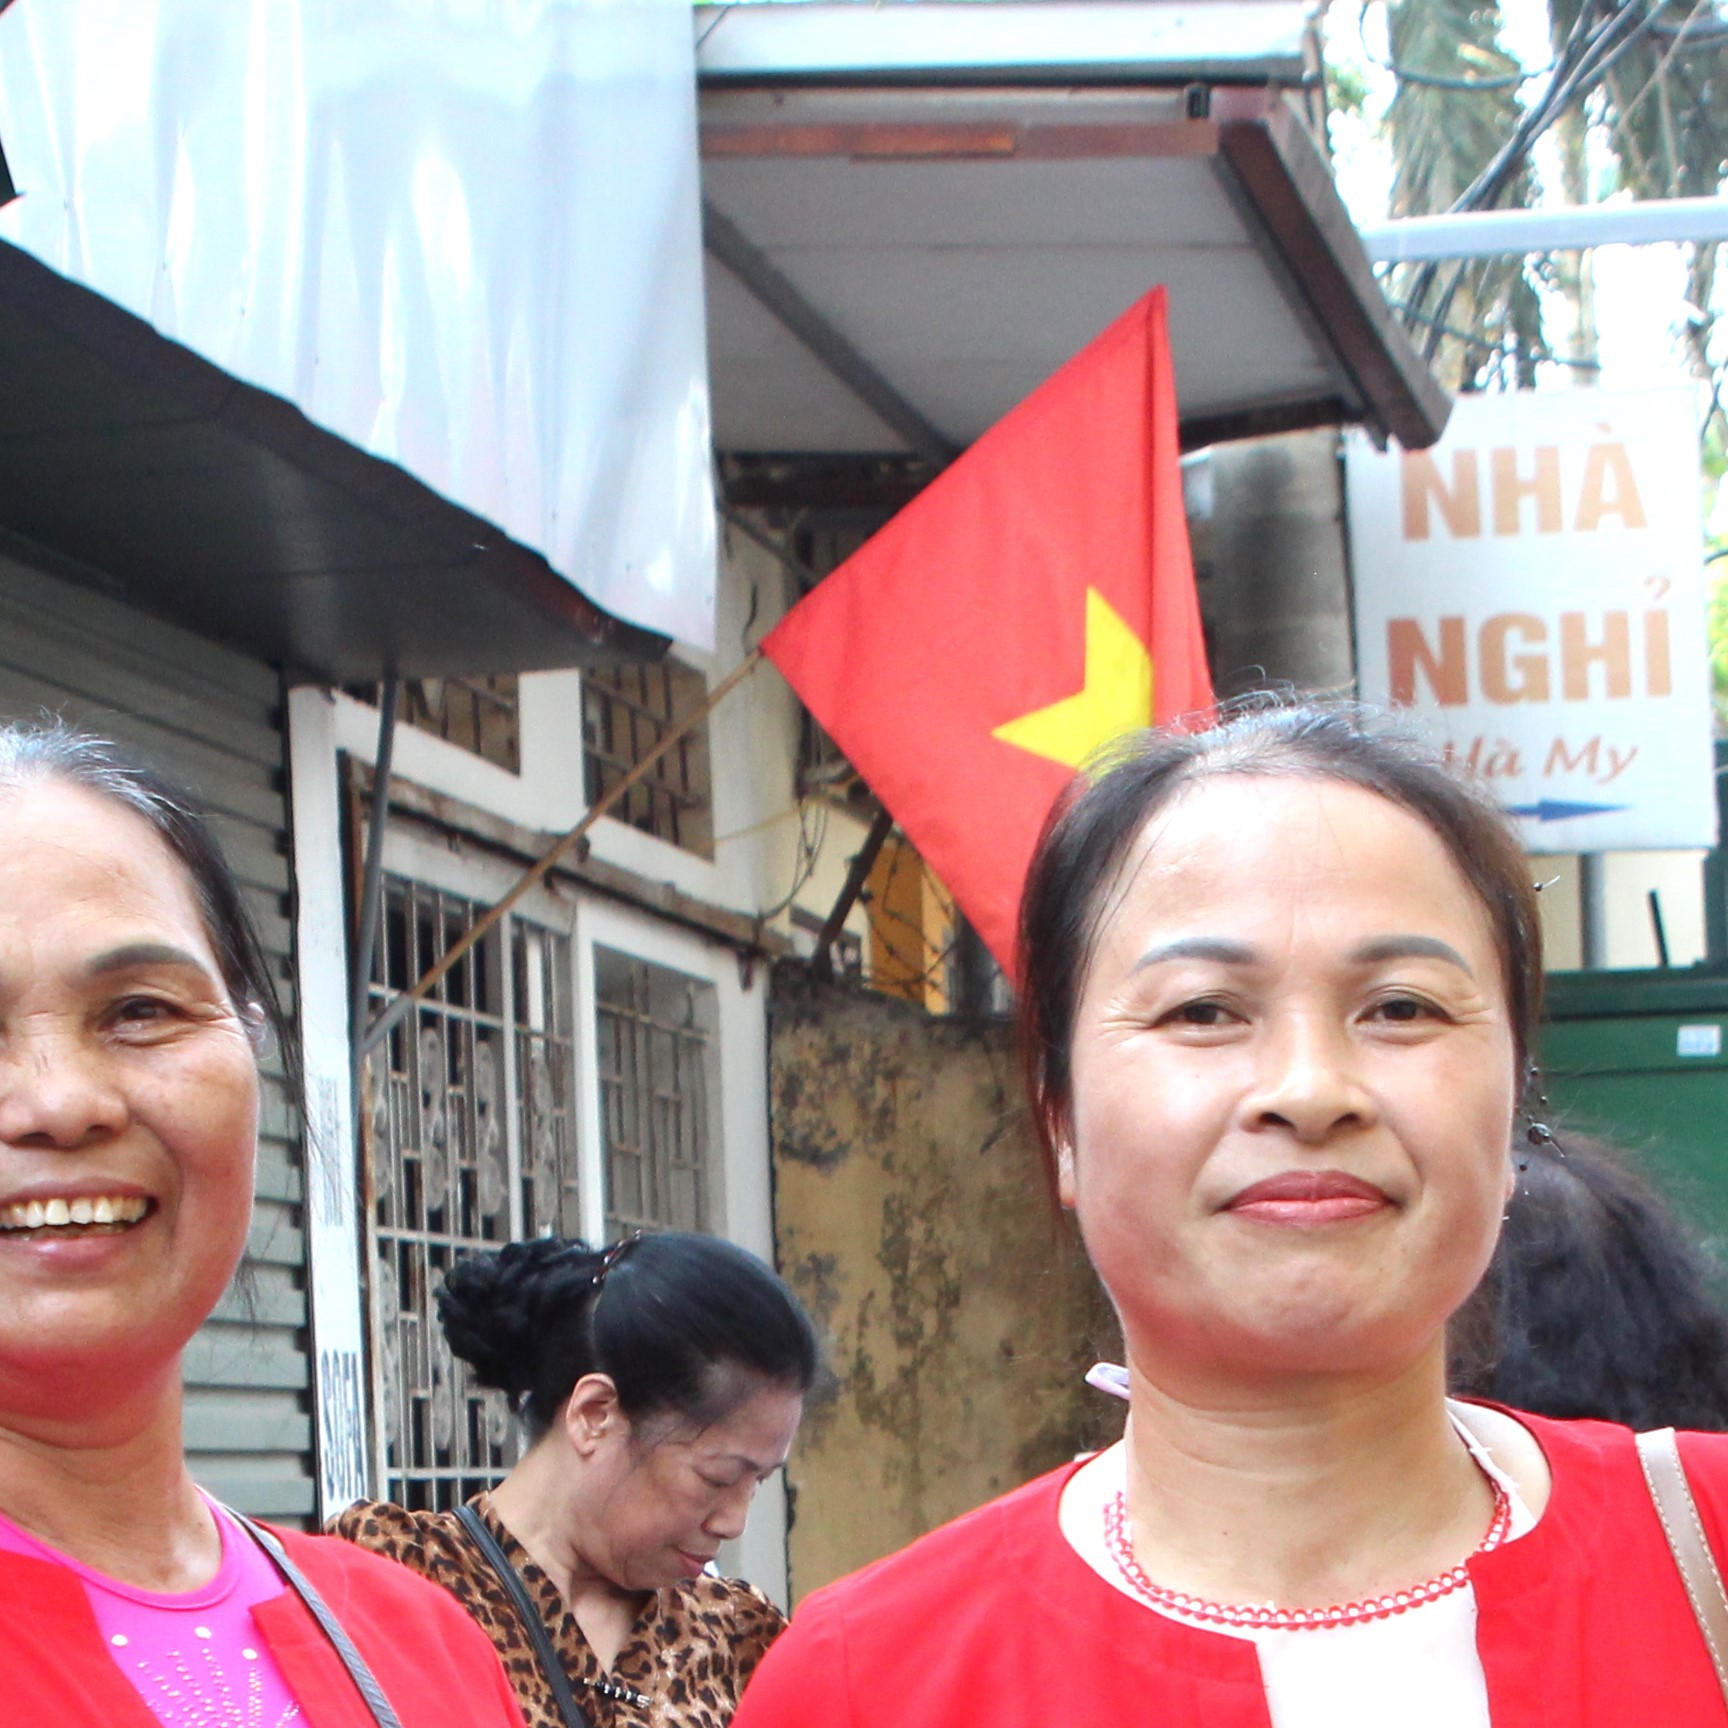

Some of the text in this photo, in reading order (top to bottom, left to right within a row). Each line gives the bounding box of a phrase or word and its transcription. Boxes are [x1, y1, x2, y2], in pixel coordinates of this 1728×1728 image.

[1400, 421, 1648, 542] NHÀ
[1386, 575, 1672, 710] NGHỈ
[1542, 734, 1639, 786] My
